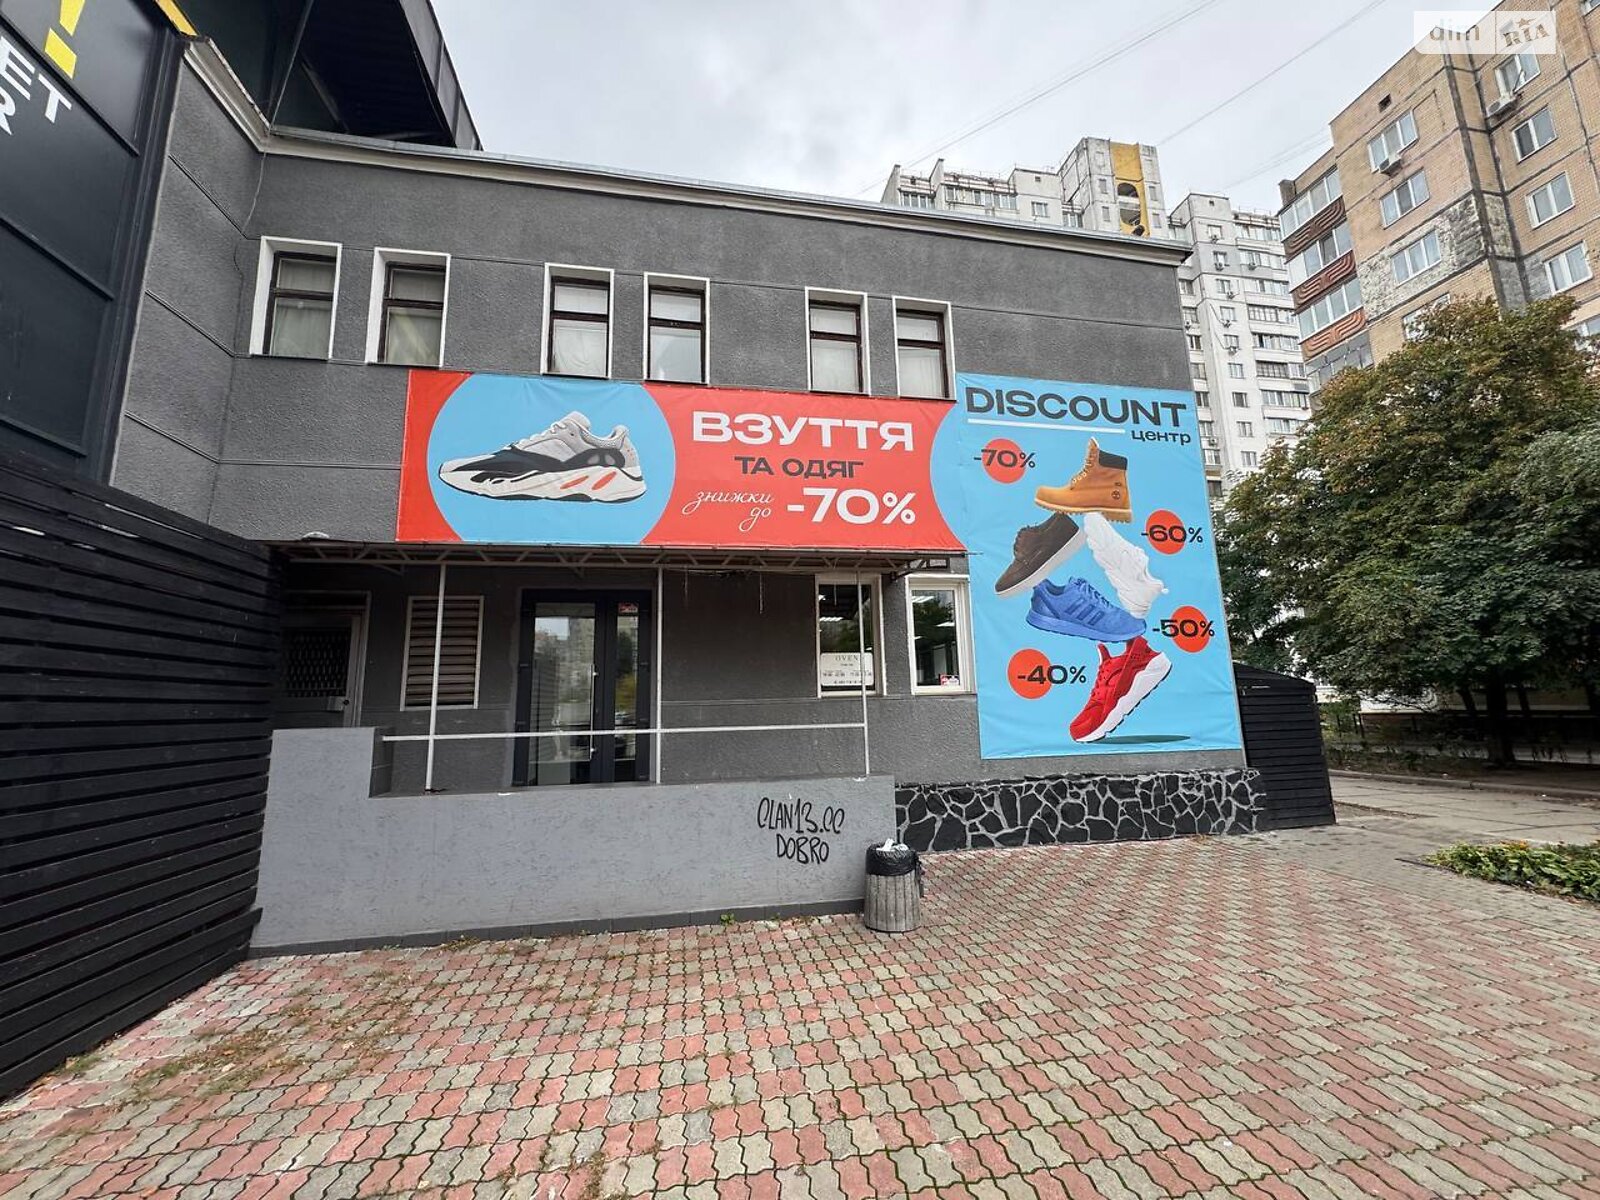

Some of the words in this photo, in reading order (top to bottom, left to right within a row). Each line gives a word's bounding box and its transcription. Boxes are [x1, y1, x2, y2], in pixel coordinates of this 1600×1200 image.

[965, 386, 1186, 427] DISCOUNT
[692, 411, 914, 451] ВЗУТТЯ
[1131, 429, 1191, 446] центр
[734, 455, 774, 476] ТА
[782, 458, 864, 479] ОДЯГ
[973, 448, 1036, 469] -70%
[682, 490, 774, 515] знижки
[787, 487, 916, 525] -70%
[739, 506, 771, 532] до
[1140, 523, 1204, 544] -60%
[1152, 618, 1215, 638] -50%
[1017, 664, 1087, 685] -40%
[776, 833, 830, 864] DOBRO
